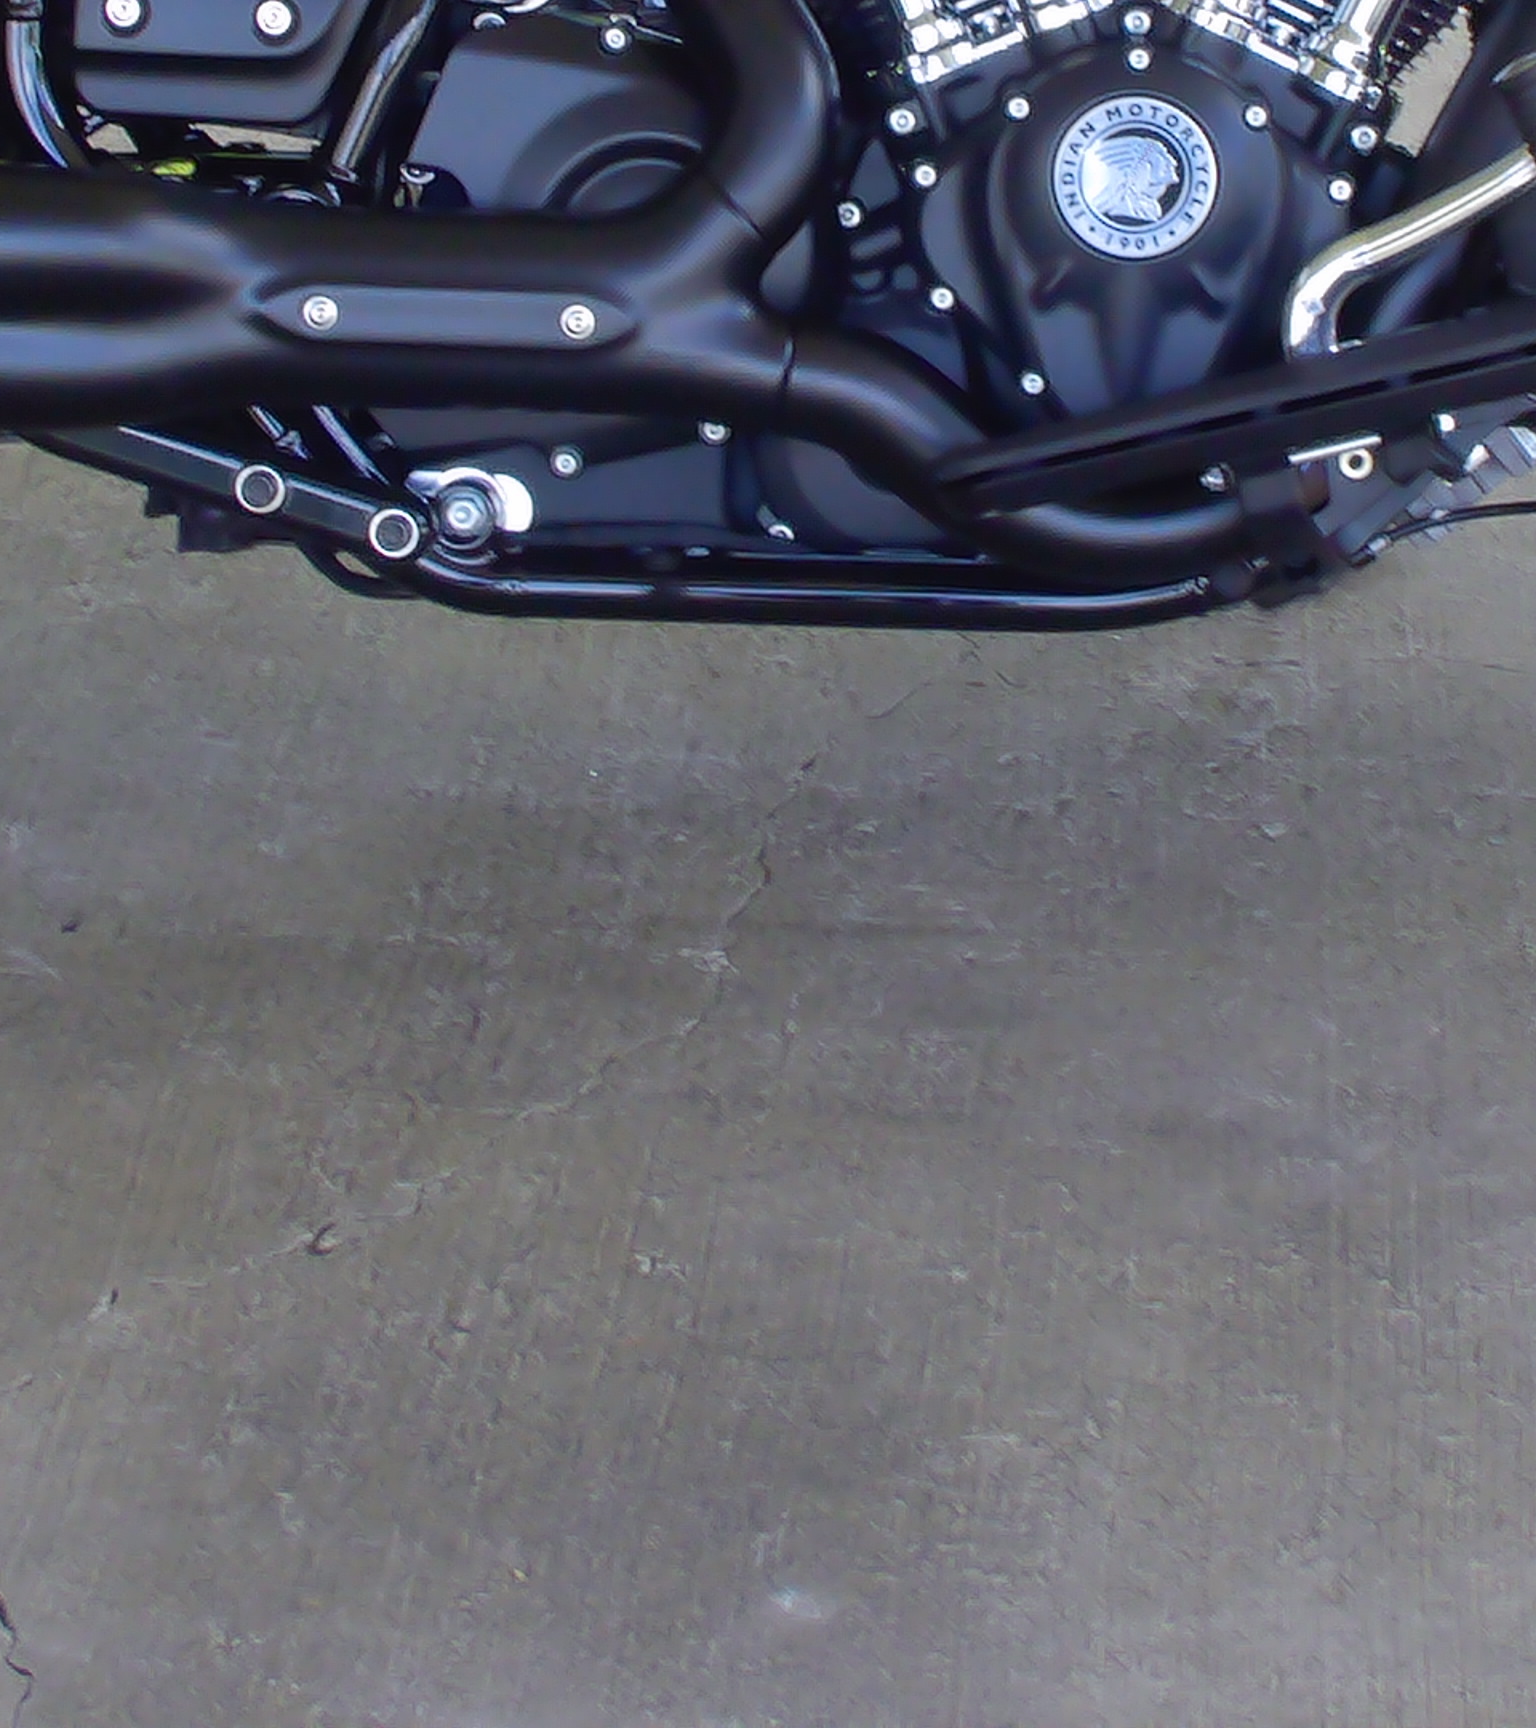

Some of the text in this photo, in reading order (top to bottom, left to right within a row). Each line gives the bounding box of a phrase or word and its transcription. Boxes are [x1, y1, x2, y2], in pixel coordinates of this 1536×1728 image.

[1062, 104, 1209, 226] INDIAN MOTORCYCLE
[1105, 233, 1160, 250] 1901
